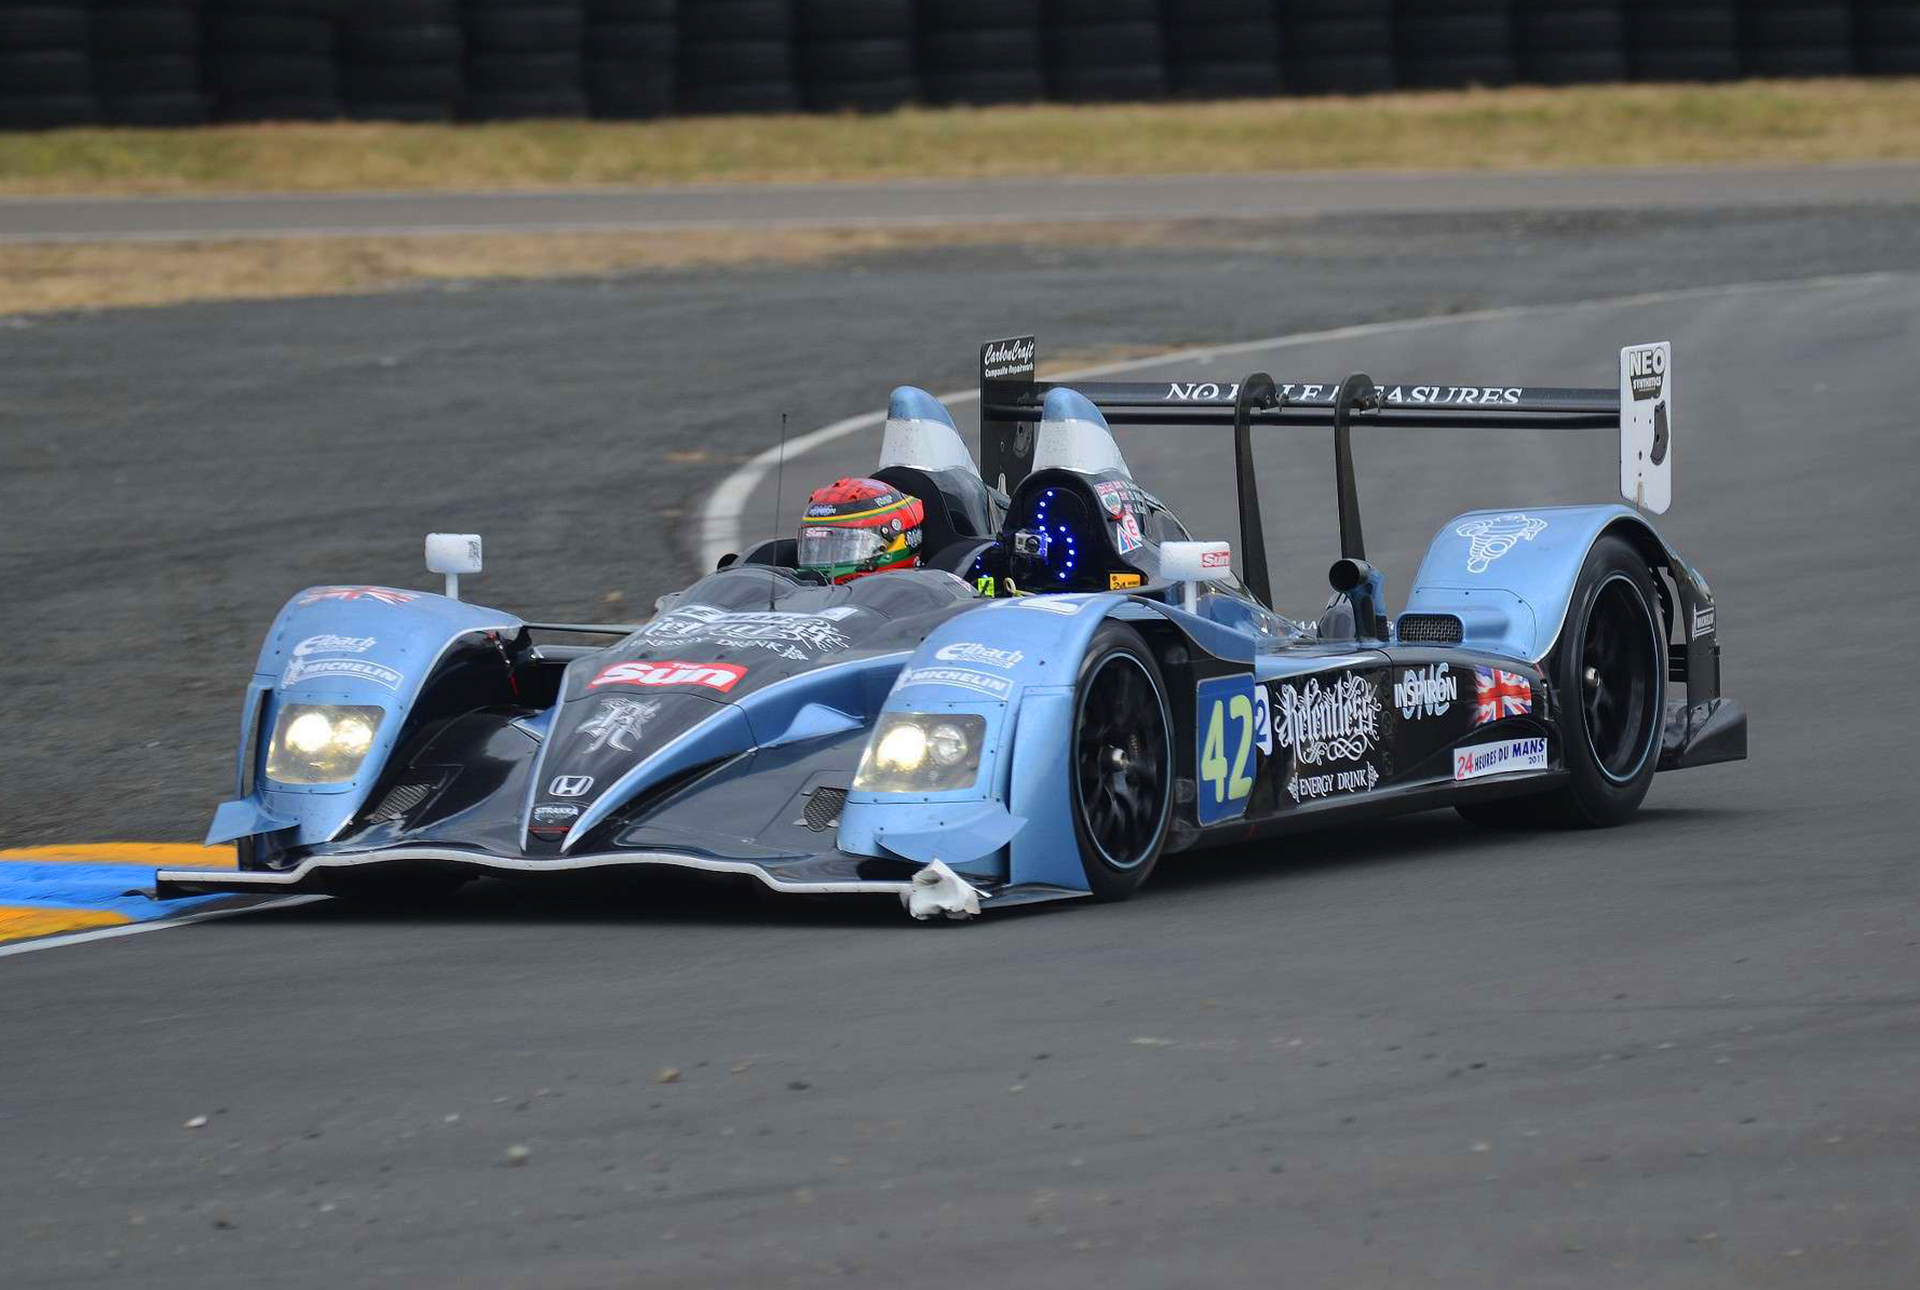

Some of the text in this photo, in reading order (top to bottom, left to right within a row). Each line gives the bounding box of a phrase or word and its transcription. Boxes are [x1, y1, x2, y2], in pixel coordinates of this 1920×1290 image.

[1629, 347, 1666, 376] NEO
[1165, 383, 1219, 400] NO
[302, 661, 398, 682] MICHELIN
[911, 669, 1009, 692] MICHELIN
[1201, 694, 1254, 803] 42
[1457, 738, 1545, 781] 24 HEURES DU MANS
[1528, 754, 1545, 766] 2011
[1299, 770, 1369, 799] ENERGY DRINK
